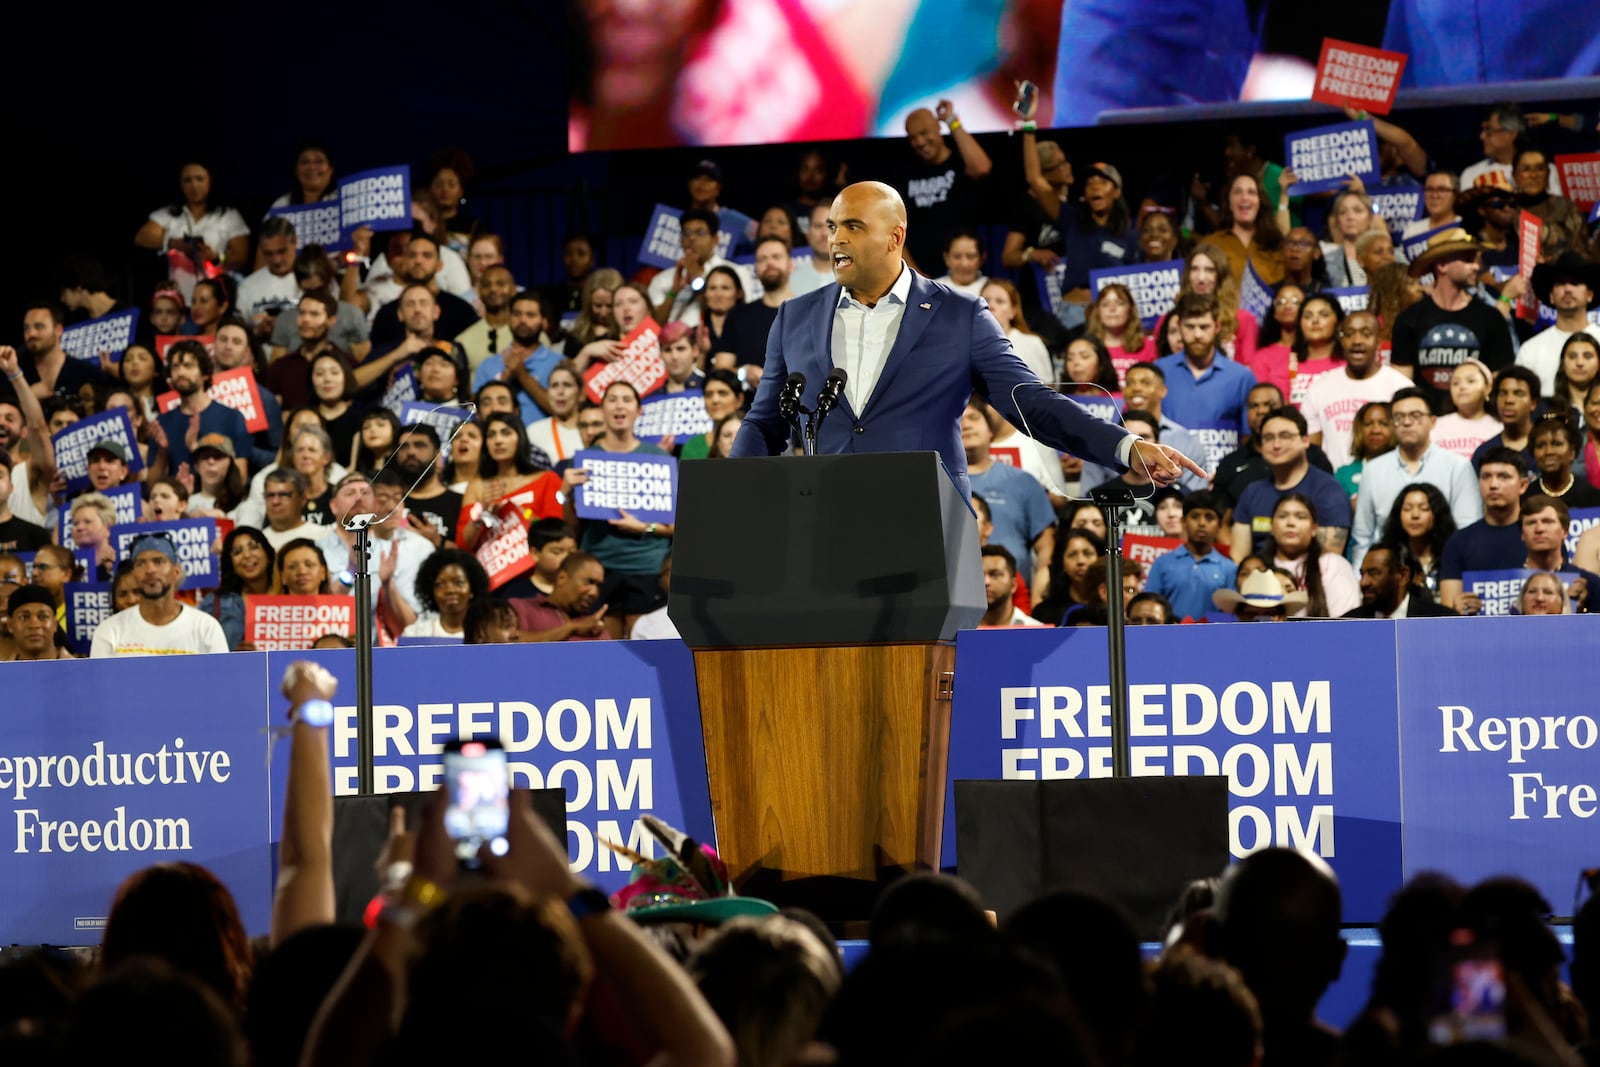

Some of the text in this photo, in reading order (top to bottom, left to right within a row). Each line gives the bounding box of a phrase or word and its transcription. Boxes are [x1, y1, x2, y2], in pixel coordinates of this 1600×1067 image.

[1327, 48, 1399, 74] FREEDOM
[1323, 63, 1395, 88] FREEDOM
[1320, 77, 1390, 103] FREEDOM
[1291, 128, 1369, 153] FREEDOM
[1292, 143, 1371, 168] FREEDOM
[1294, 158, 1373, 183] FREEDOM
[341, 174, 403, 200] FREEDOM
[341, 188, 404, 214] FREEDOM
[342, 203, 405, 229] FREEDOM
[62, 314, 132, 343] FREEDOM
[55, 416, 124, 453] FREEDOM
[583, 459, 671, 480] FREEDOM
[583, 491, 673, 512] FREEDOM
[254, 605, 351, 623] FREEDOM
[254, 622, 350, 640] FREEDOM
[1000, 680, 1332, 739] FREEDOM
[333, 698, 652, 757] FREEDOM
[14, 806, 193, 853] Freedom
